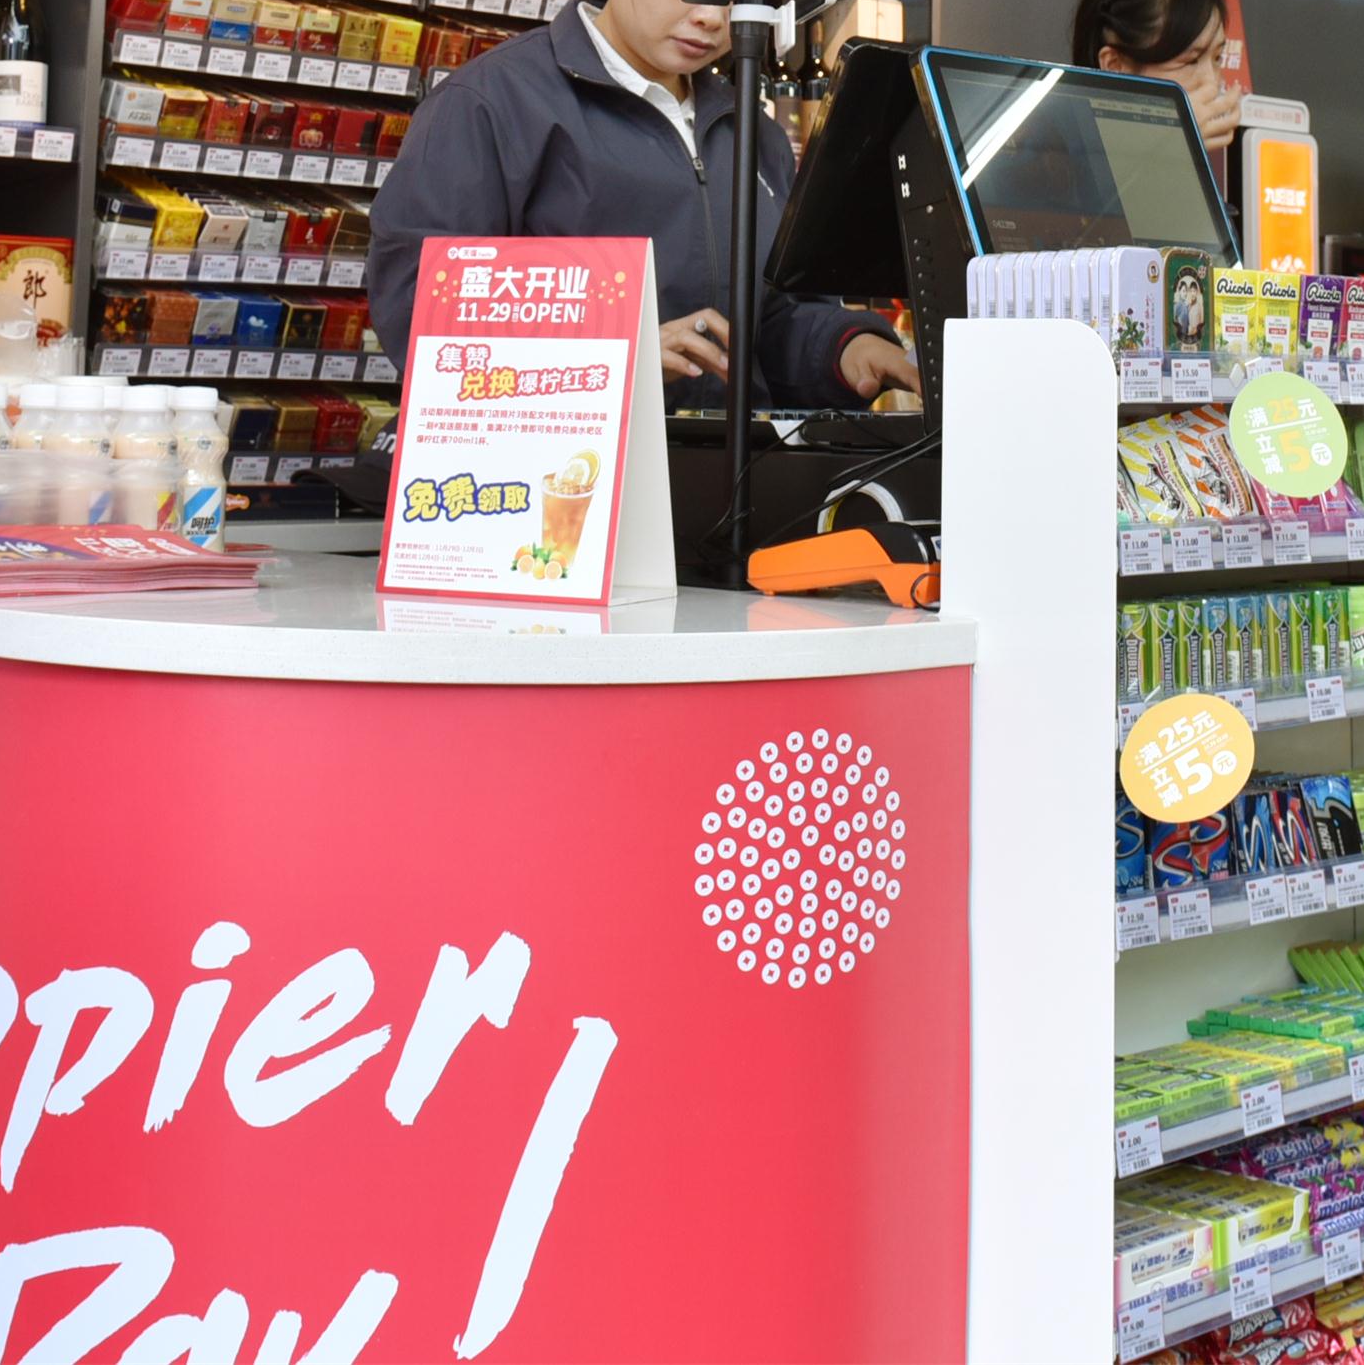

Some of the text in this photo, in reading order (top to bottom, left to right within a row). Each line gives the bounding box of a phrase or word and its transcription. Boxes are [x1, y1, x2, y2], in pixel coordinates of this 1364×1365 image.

[23, 270, 47, 299] 郎
[459, 266, 590, 299] 盛大开业
[1217, 278, 1254, 296] Ricola
[1261, 281, 1296, 299] Ricola
[1307, 283, 1341, 302] Ricola
[436, 344, 490, 372] 集赞
[458, 364, 608, 400] 兑换爆柠红茶
[403, 473, 530, 523] 免费领取
[1174, 748, 1214, 795] 5
